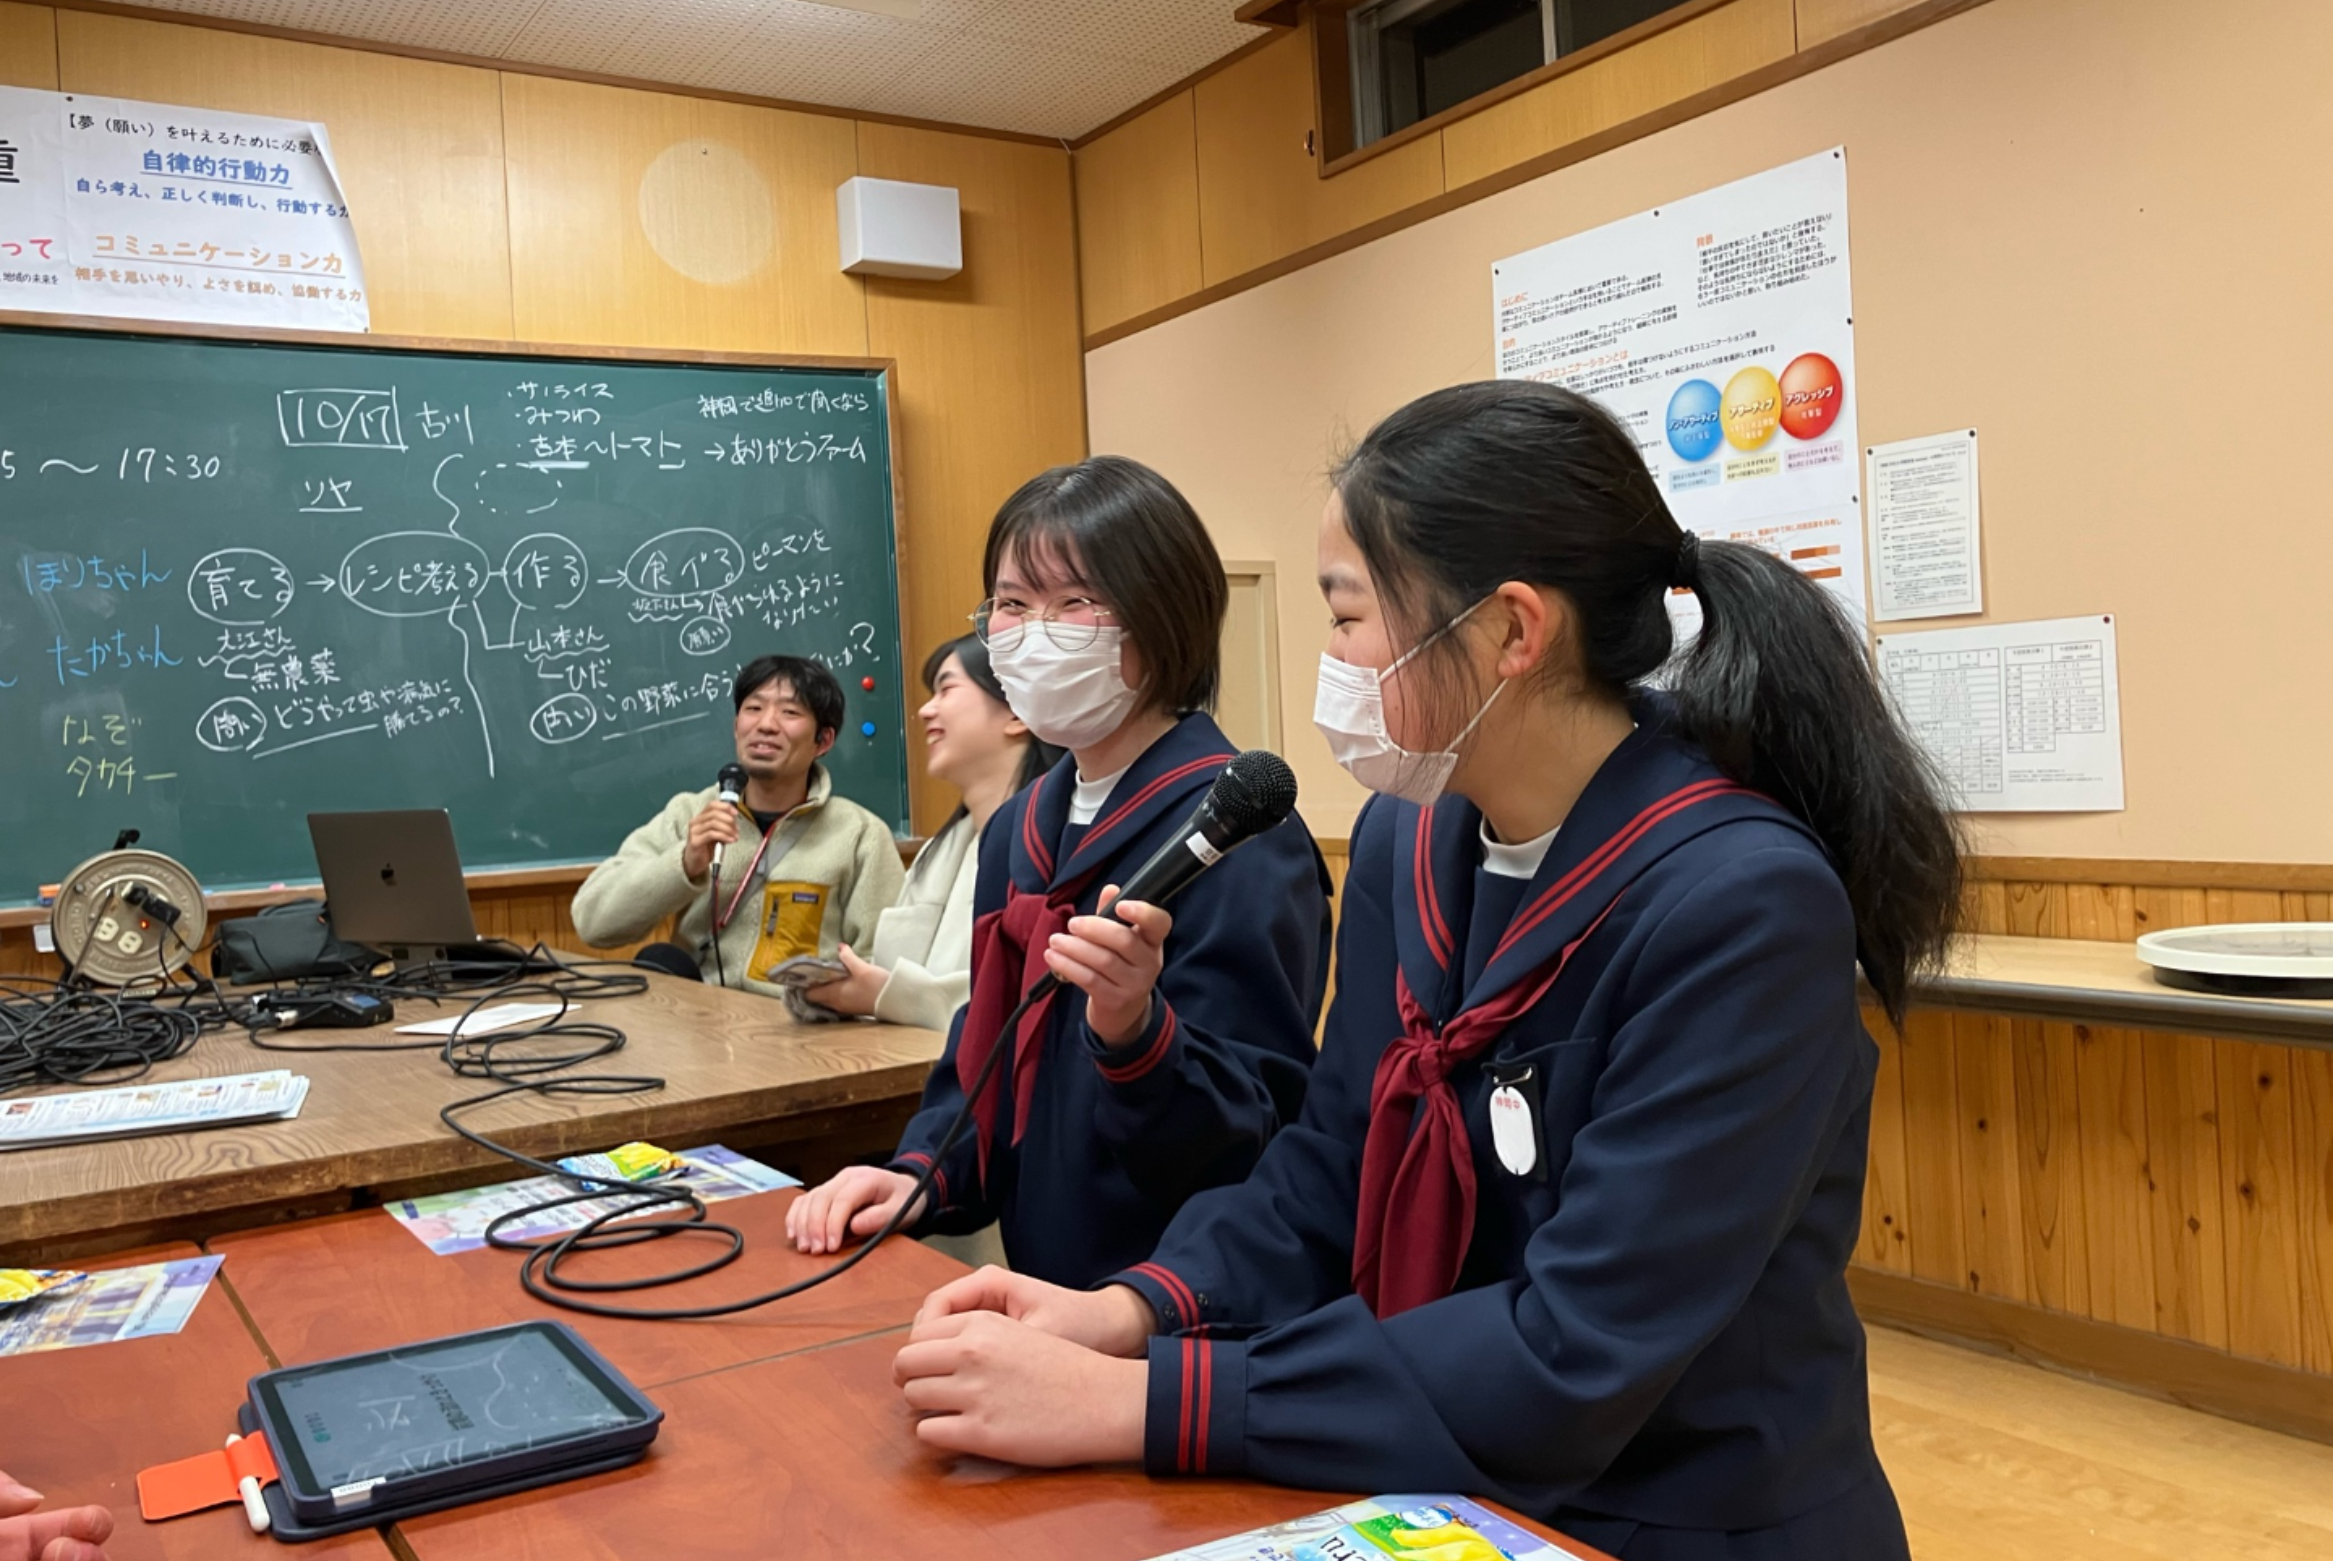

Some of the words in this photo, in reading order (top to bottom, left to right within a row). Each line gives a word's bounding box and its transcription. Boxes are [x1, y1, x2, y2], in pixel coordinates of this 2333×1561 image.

[143, 149, 290, 185] 自律的行動力
[95, 234, 343, 274] コミュニケーション力
[298, 395, 391, 444] 10/17
[119, 448, 221, 483] 17:30
[730, 431, 866, 465] ありがとうファーム
[513, 550, 581, 589] 作る
[640, 549, 734, 590] 食べる
[752, 529, 832, 571] ピーマンを
[199, 558, 293, 611] 育てる
[346, 560, 479, 597] レシピ考える
[46, 624, 184, 686] たかちゃん
[528, 625, 604, 652] 山本さん
[251, 648, 340, 693] 無農薬
